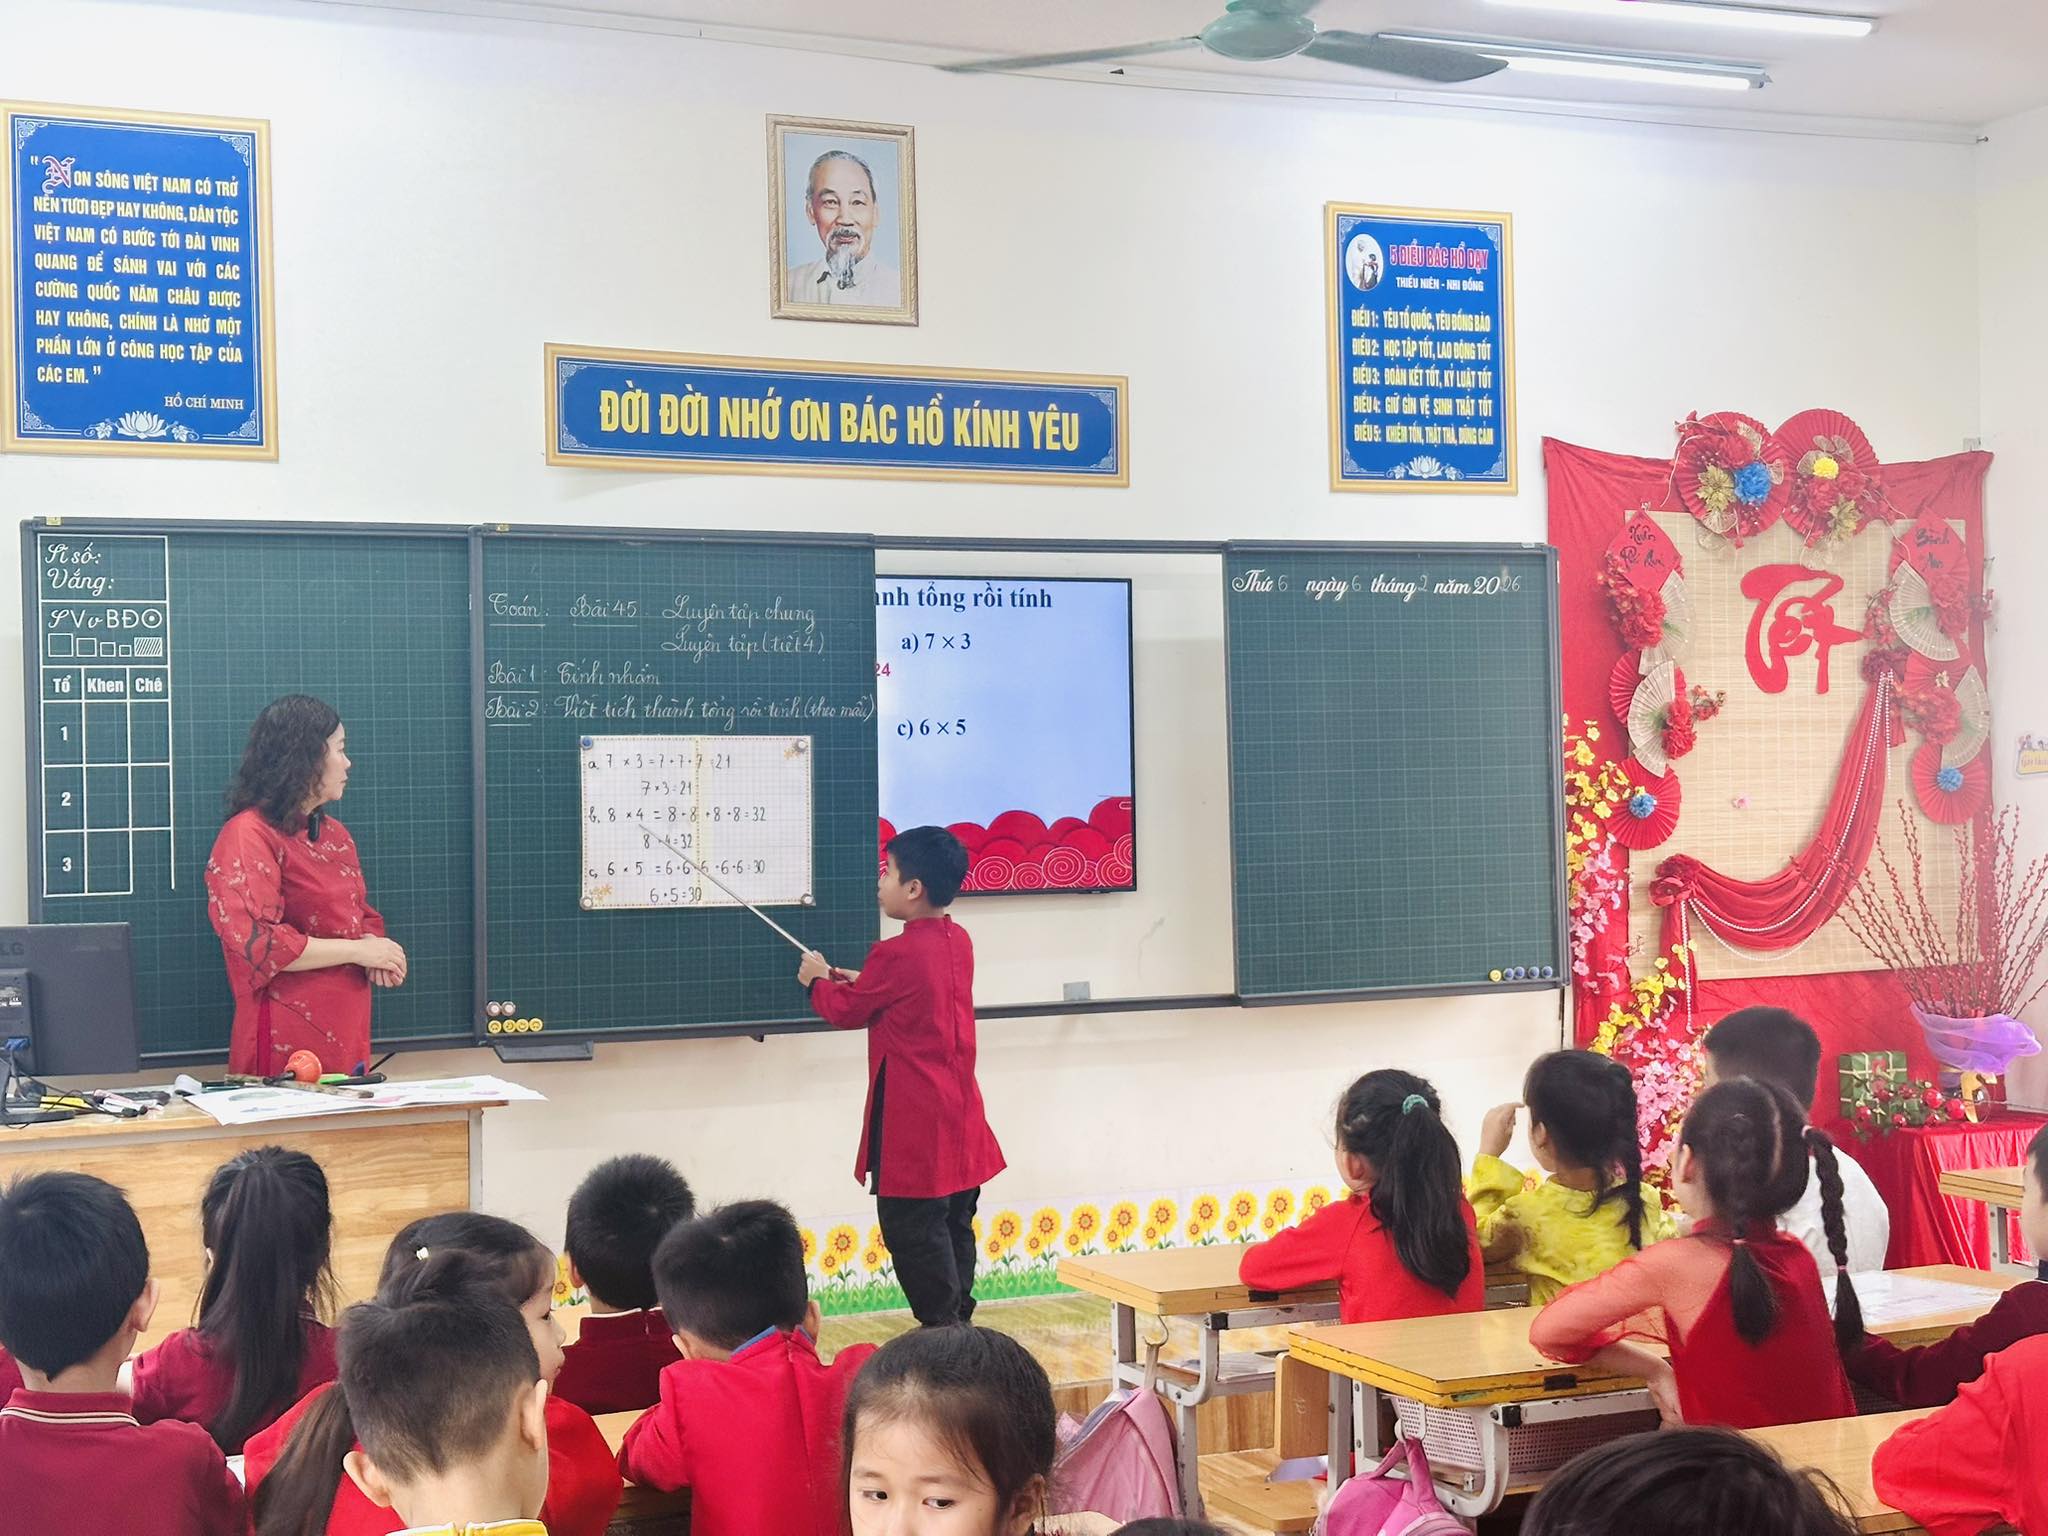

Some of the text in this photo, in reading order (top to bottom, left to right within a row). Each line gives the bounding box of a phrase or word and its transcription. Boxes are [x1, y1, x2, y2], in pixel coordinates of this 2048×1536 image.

[95, 170, 129, 189] SÔNG
[133, 173, 158, 194] VIỆT
[162, 177, 191, 194] NAM
[195, 174, 211, 195] CÓ
[215, 176, 238, 197] TRỞ
[33, 193, 238, 228] NÊN TƯƠI ĐẸP HAY KHÔNG, DÂN TỘC
[34, 222, 239, 252] VIỆT NAM CÓ BƯỚC TỚI ĐÀI VINH
[35, 253, 77, 270] QUANG
[114, 256, 147, 274] SÁNH
[157, 260, 177, 276] VAI
[187, 257, 206, 278] VỚI
[216, 260, 240, 280] CÁC
[1390, 244, 1398, 266] 5
[1426, 242, 1448, 268] BÁC
[1467, 248, 1489, 274] DẠY
[35, 279, 240, 310] CƯỜNG QUỐC NĂM CHÂU ĐƯỢC
[36, 310, 241, 338] HAY KHÔNG, CHÍNH LÀ NHỜ MỘT
[77, 336, 100, 356] LỚN
[107, 335, 115, 357] Ở
[121, 340, 154, 359] CÔNG
[160, 343, 184, 363] HỌC
[190, 343, 212, 364] TẬP
[218, 341, 243, 363] CỦA
[37, 364, 62, 383] CÁC
[186, 395, 206, 408] CHÍ
[210, 398, 243, 409] MINH
[600, 379, 1079, 452] ĐỜI ĐỜI NHỚ ƠN BÁC HỒ KÍNH YÊU
[47, 568, 114, 596] Vắng:
[1232, 569, 1274, 592] Thứ
[1305, 576, 1349, 601] ngày
[1371, 573, 1417, 602] tháng
[1434, 578, 1471, 594] năm
[917, 581, 1052, 612] tổng rồi tính
[765, 597, 815, 633] chung
[901, 633, 971, 653] a) 7 3
[53, 675, 162, 693] Tổ Khen Chê
[61, 727, 68, 740] 1
[897, 719, 966, 739] c) 6 5
[61, 792, 71, 807] 2
[62, 857, 72, 872] 3
